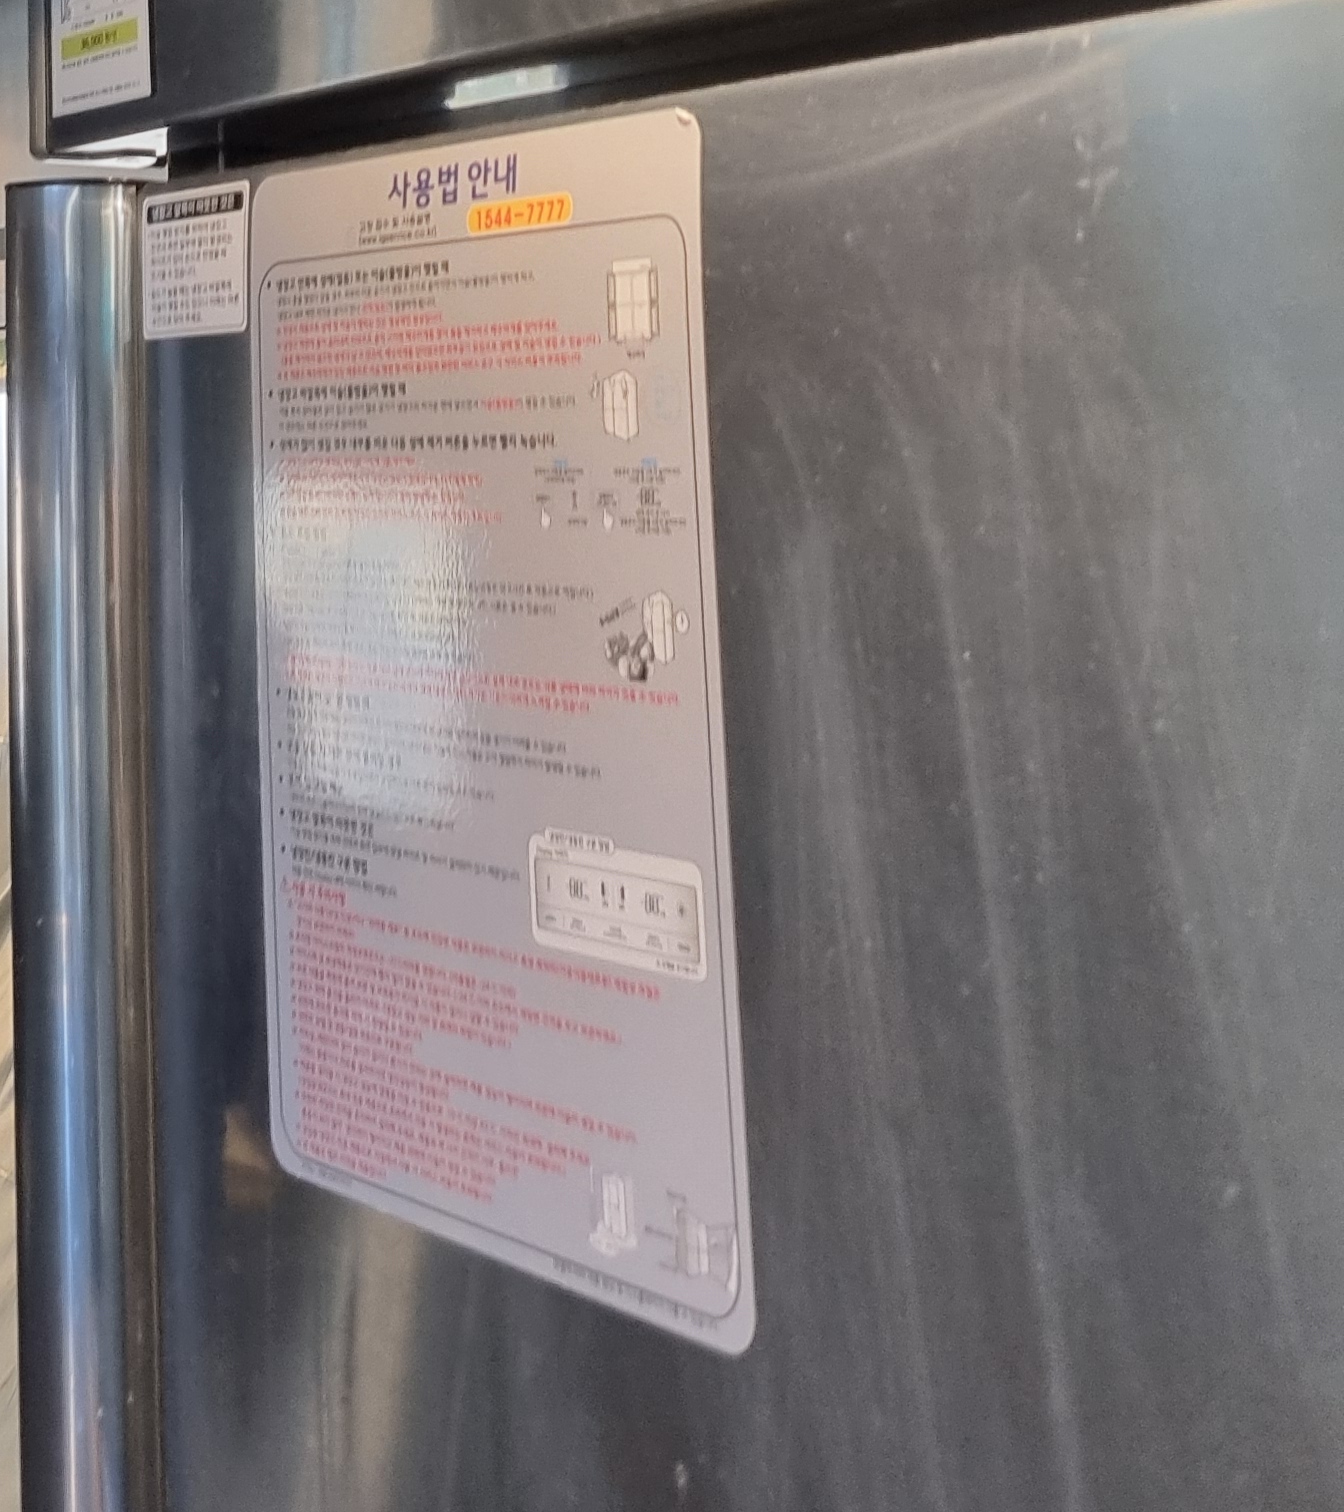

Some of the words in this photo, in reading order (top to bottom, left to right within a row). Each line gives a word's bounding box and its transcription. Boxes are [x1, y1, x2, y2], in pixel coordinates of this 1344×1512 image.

[388, 162, 459, 209] 사용법
[468, 153, 517, 201] 안내
[476, 199, 566, 232] 1544-7777
